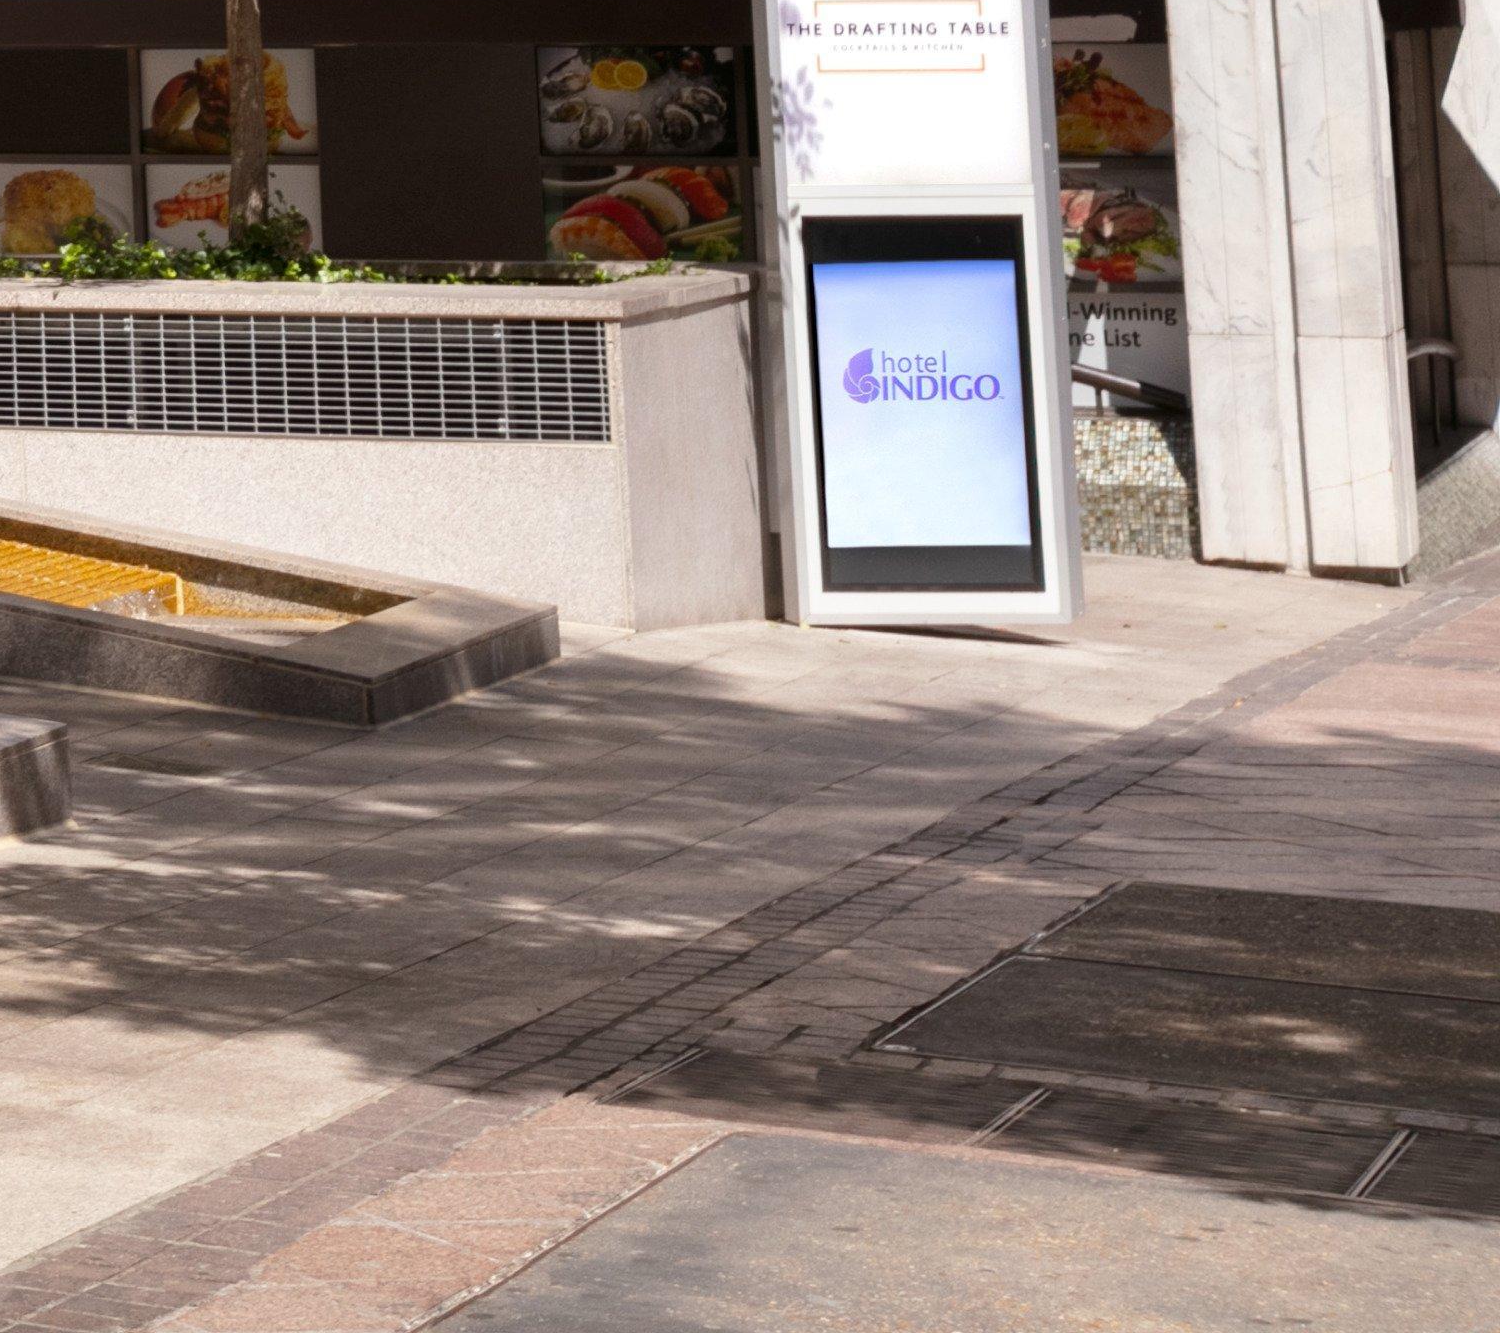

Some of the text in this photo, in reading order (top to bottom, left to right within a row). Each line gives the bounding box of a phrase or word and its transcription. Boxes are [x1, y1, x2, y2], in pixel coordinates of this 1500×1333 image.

[786, 21, 1010, 36] THE DRAFTING TABLE
[1067, 302, 1177, 326] -Winning
[1069, 329, 1142, 347] ne List
[881, 350, 947, 373] hotel
[882, 374, 1001, 401] INDIGO
